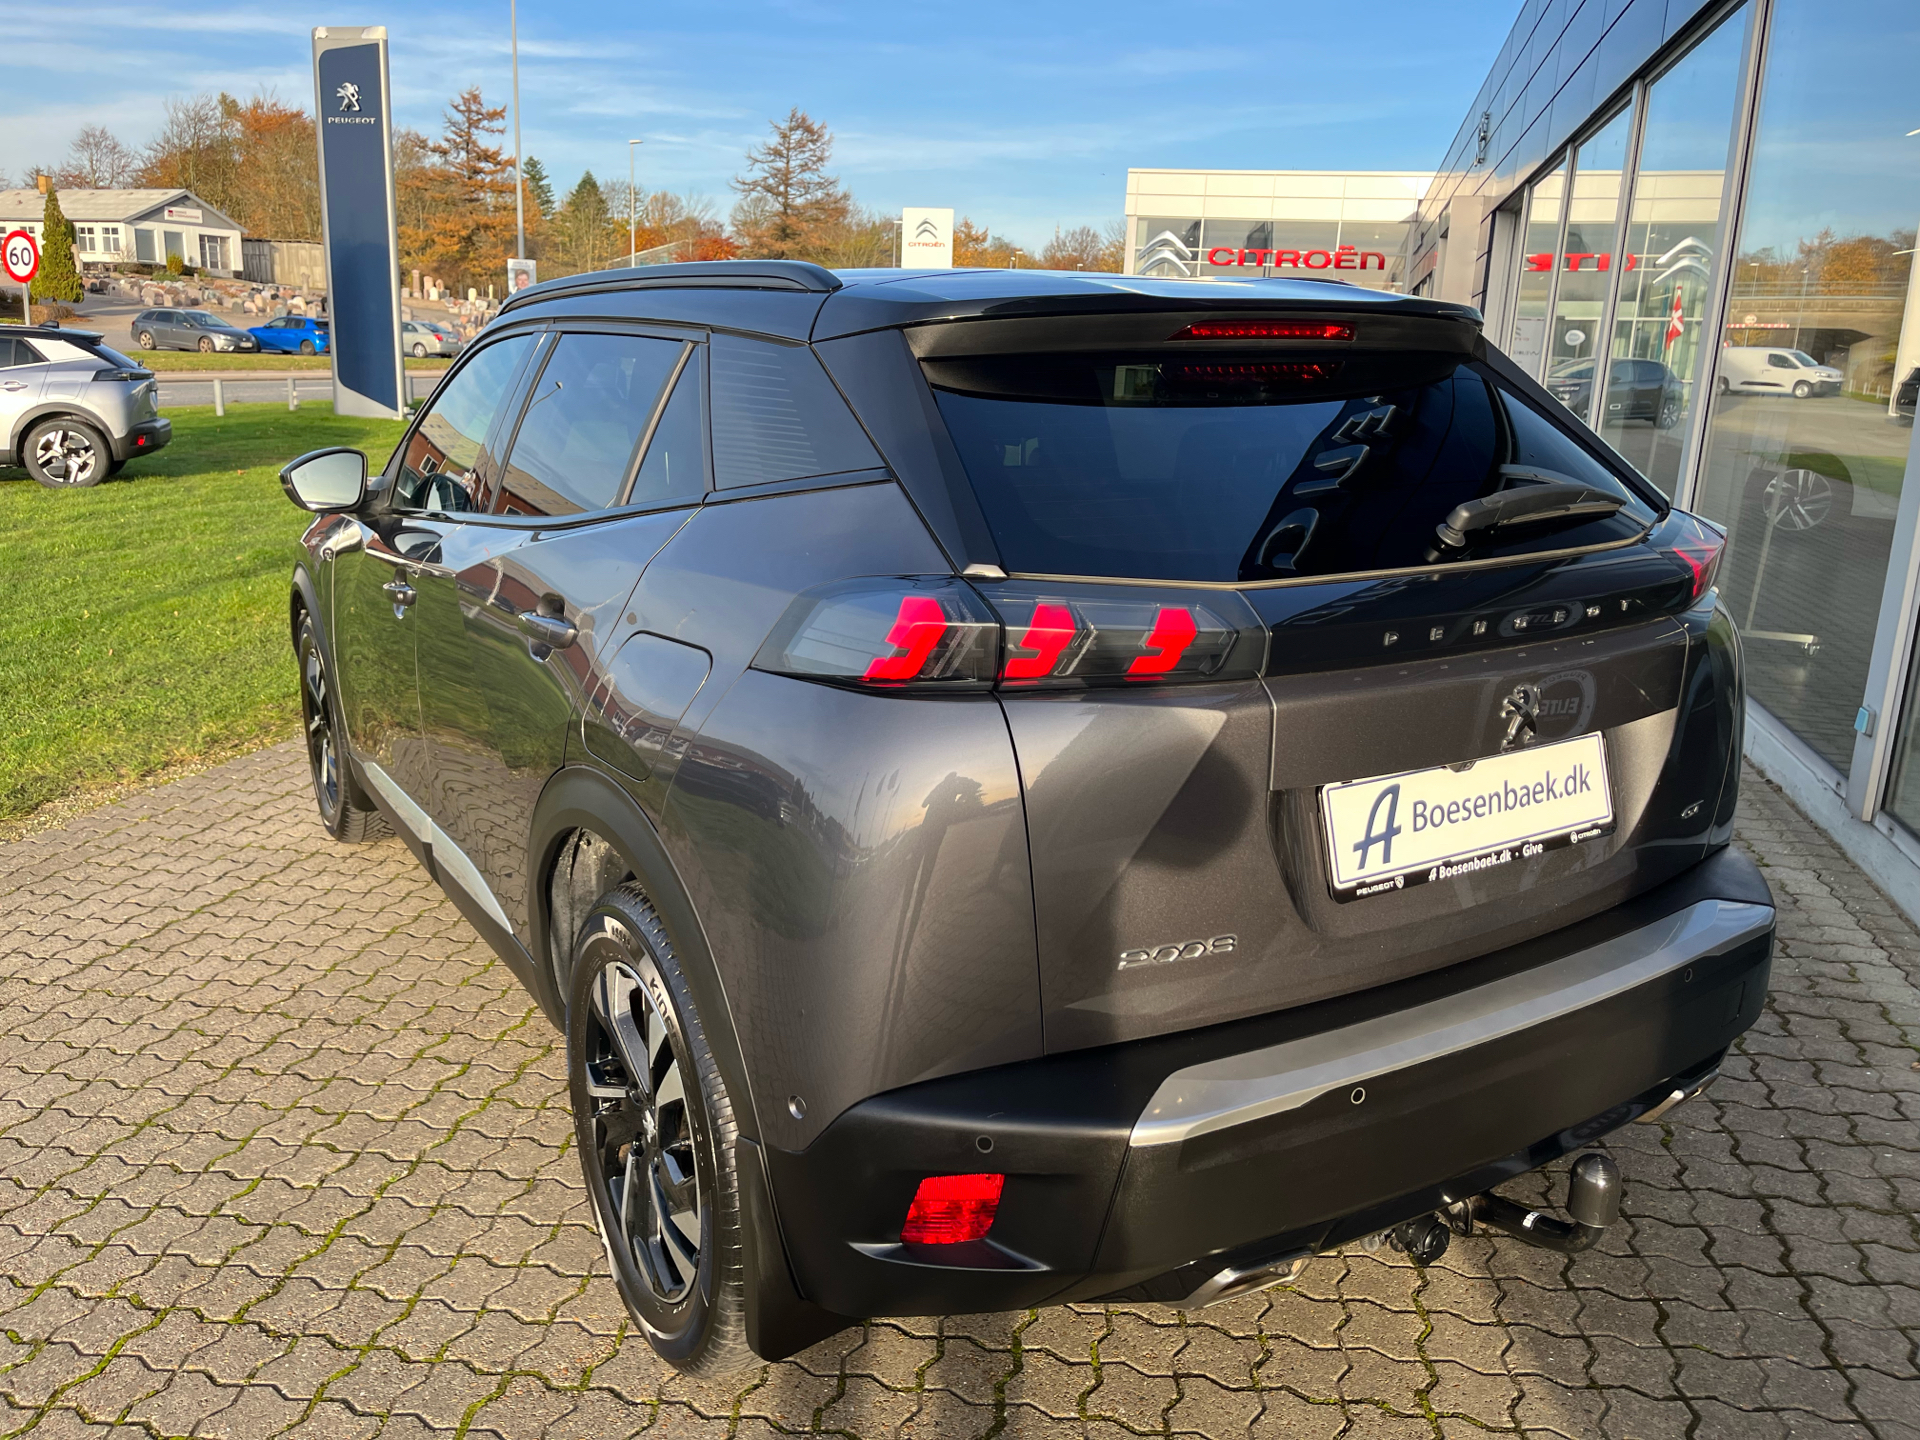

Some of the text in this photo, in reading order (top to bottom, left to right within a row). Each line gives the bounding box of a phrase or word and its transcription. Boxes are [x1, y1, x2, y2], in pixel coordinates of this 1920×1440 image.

[9, 247, 31, 266] 60
[1383, 600, 1632, 646] PEUGEOT
[1412, 763, 1592, 832] Boesenbaek.dk
[1439, 849, 1512, 879] Boesenbaek.dk
[1522, 843, 1544, 857] Give
[1356, 880, 1395, 896] PEUGEOT
[1118, 934, 1237, 970] 2008
